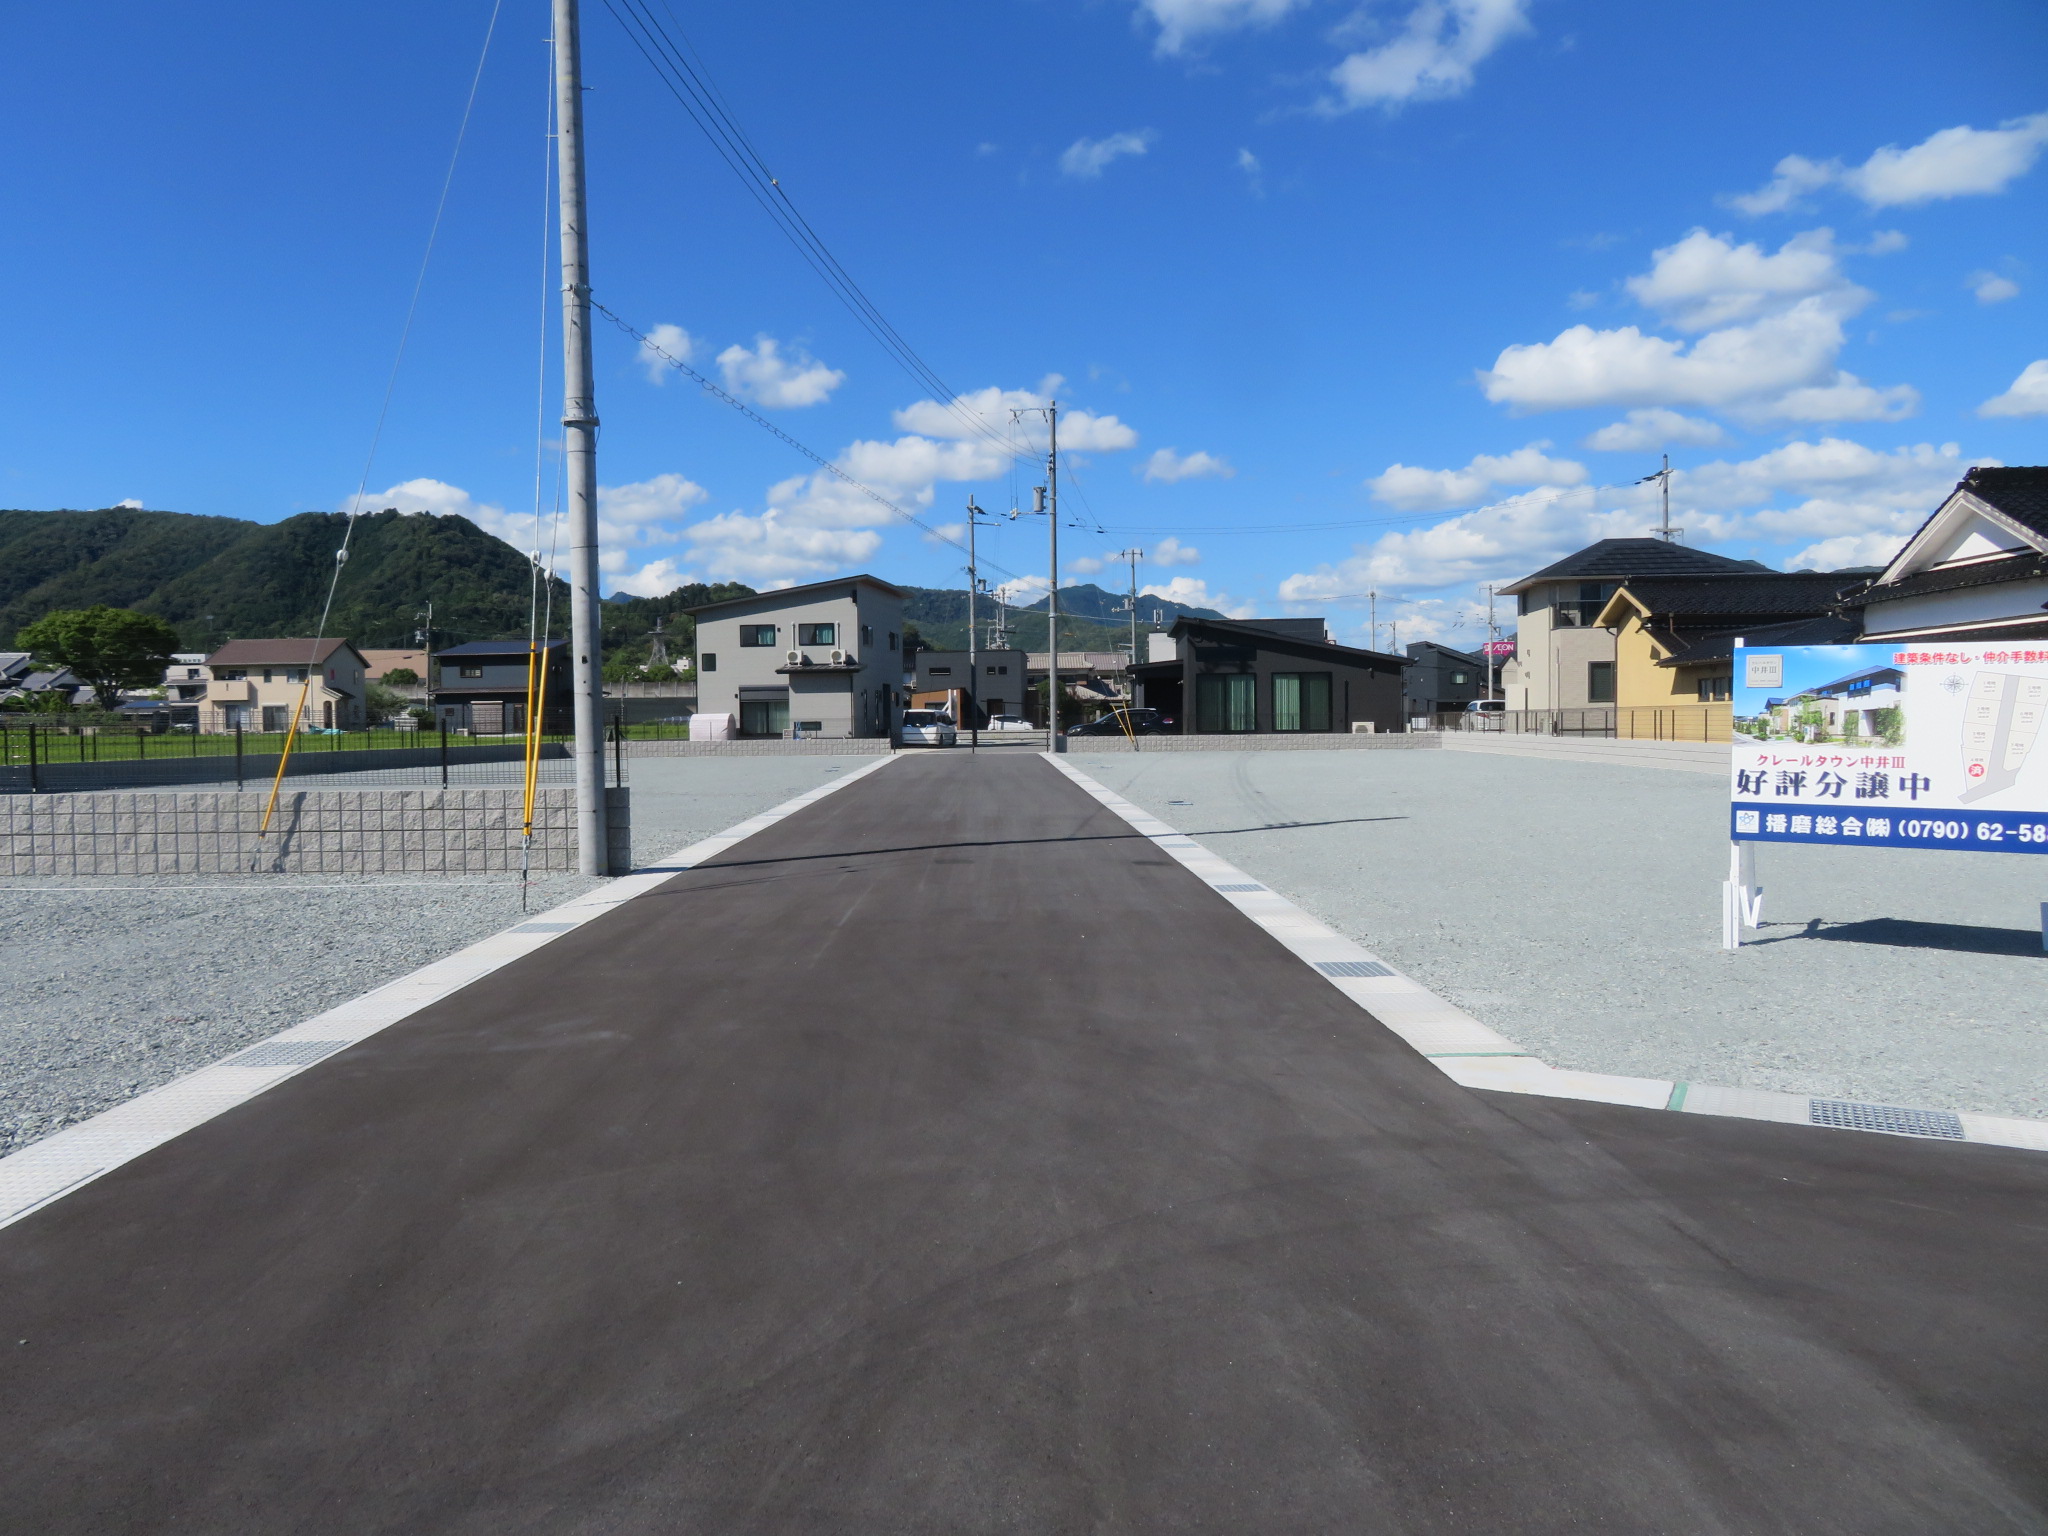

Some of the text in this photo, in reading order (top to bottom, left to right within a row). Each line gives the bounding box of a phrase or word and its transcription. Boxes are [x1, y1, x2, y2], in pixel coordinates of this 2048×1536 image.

[1736, 769, 1931, 801] 好評分譲中
[1898, 819, 1969, 840] (0790)
[1976, 822, 2048, 843] 62-58
